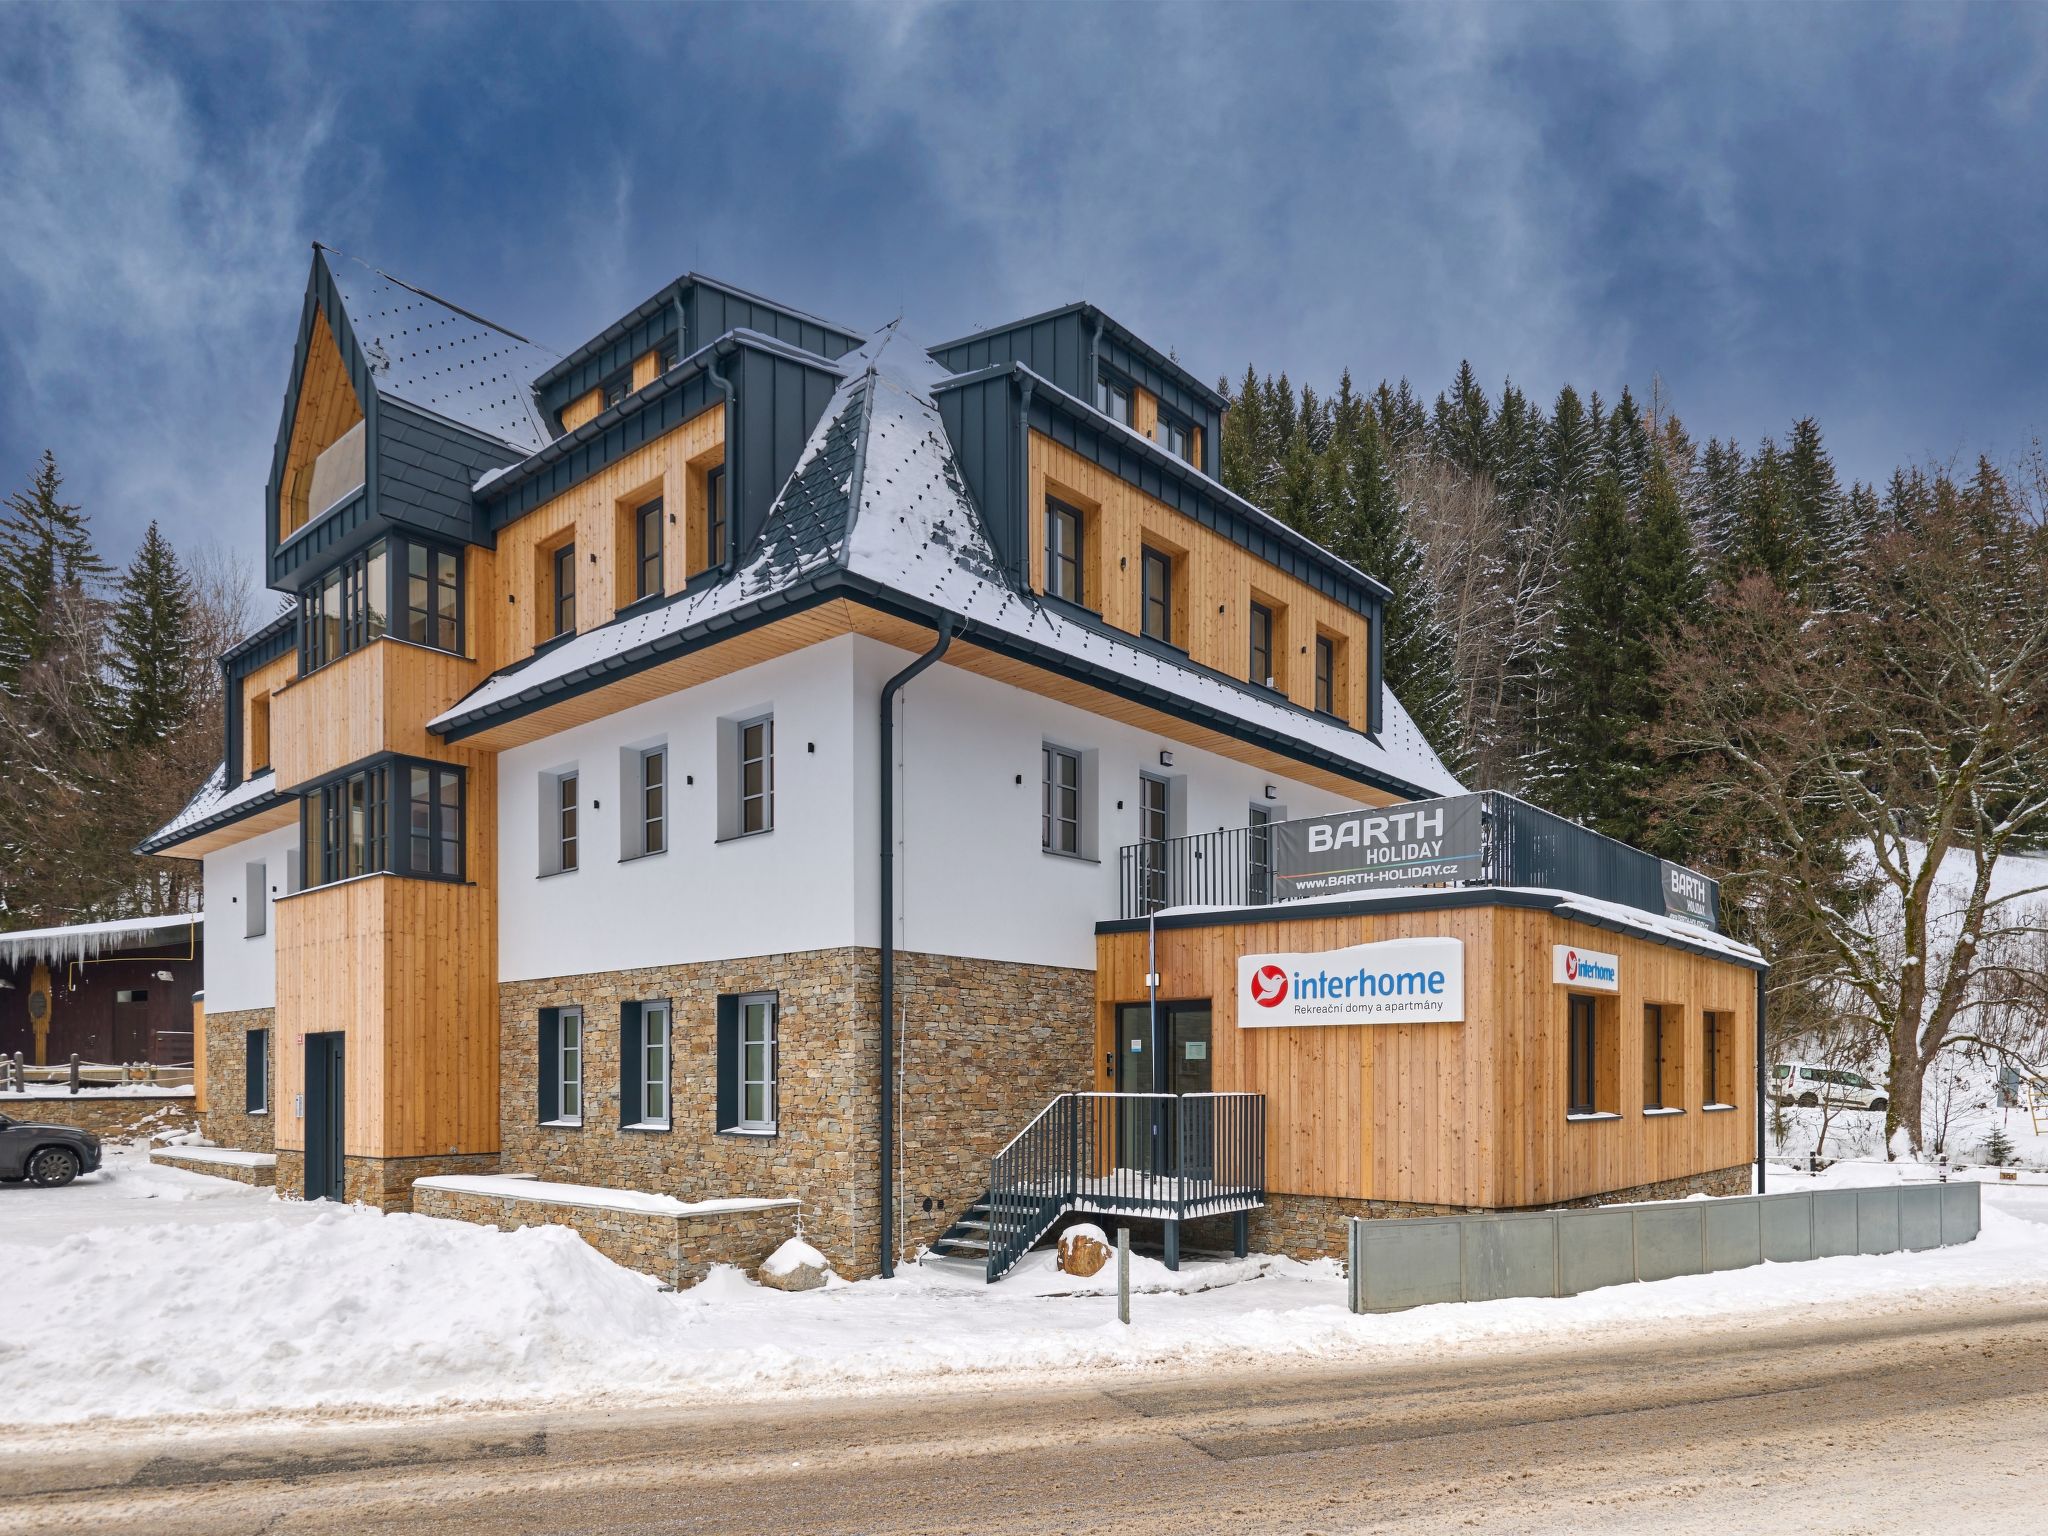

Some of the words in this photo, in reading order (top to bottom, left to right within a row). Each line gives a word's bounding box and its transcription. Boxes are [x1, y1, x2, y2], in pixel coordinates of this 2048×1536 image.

[1308, 808, 1443, 853] BARTH
[1366, 840, 1443, 865] HOLIDAY
[1296, 865, 1458, 890] www.BARTH-HOLIDAY.cz
[1671, 870, 1705, 903] BARTH
[1577, 958, 1615, 983] interhome
[1294, 968, 1445, 1000] interhome
[1295, 1003, 1343, 1015] Rekreační
[1345, 1003, 1374, 1014] domy
[1376, 1004, 1382, 1012] a
[1384, 1000, 1444, 1014] apartmány
